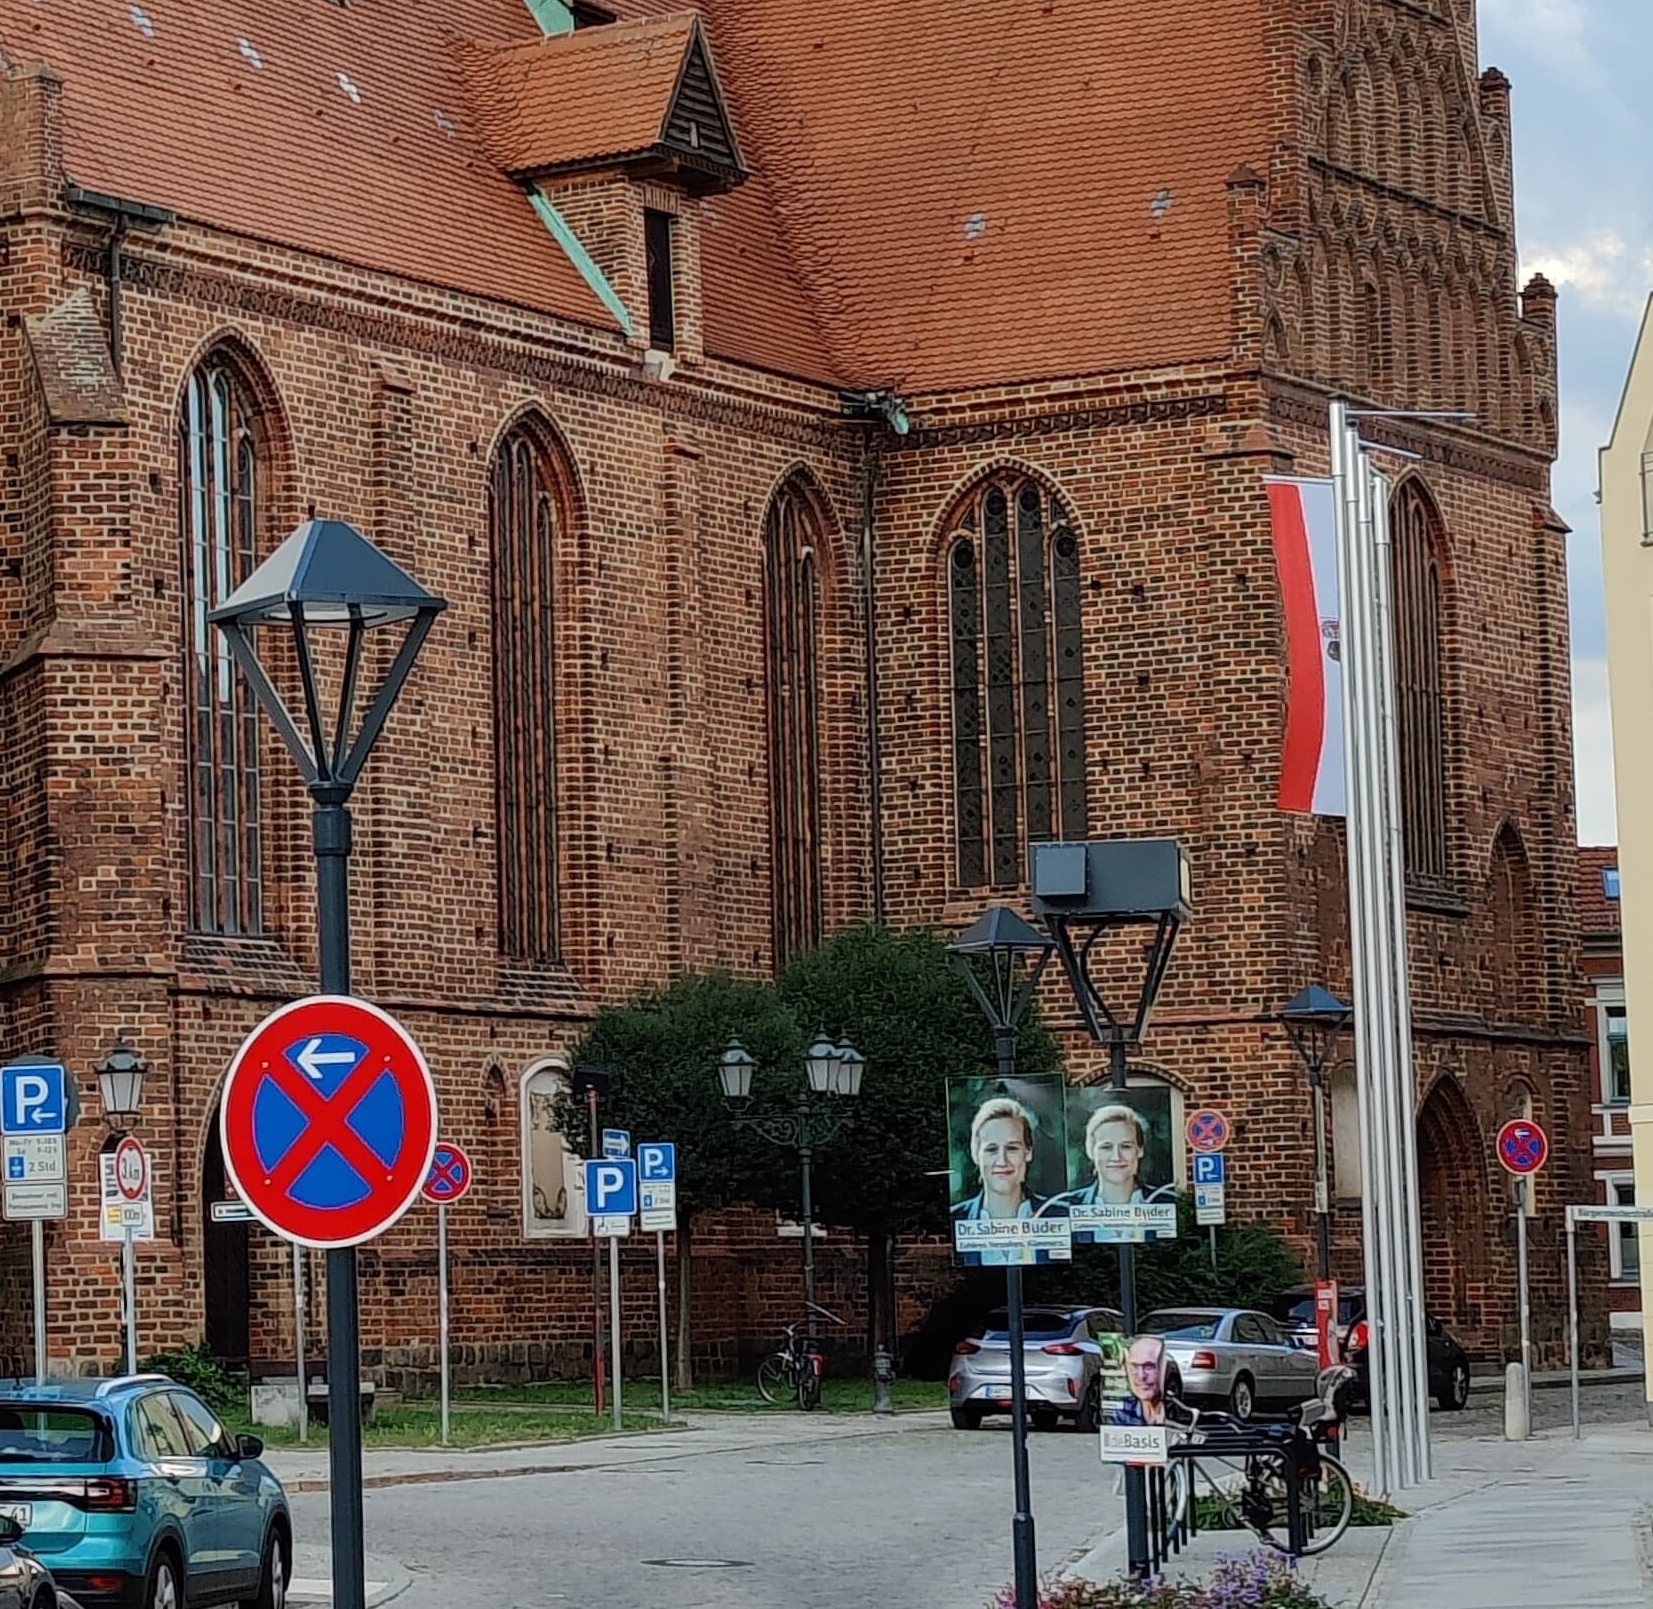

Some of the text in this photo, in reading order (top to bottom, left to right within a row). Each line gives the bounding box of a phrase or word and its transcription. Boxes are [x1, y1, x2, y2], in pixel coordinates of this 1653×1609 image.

[16, 1076, 49, 1124] P
[28, 1162, 35, 1172] 2
[644, 1148, 664, 1177] P
[1198, 1157, 1214, 1181] P
[597, 1167, 624, 1208] P
[1091, 1206, 1131, 1218] Sabine
[958, 1223, 975, 1236] Dr.
[977, 1221, 1019, 1235] Sabine
[1021, 1221, 1065, 1234] Buder
